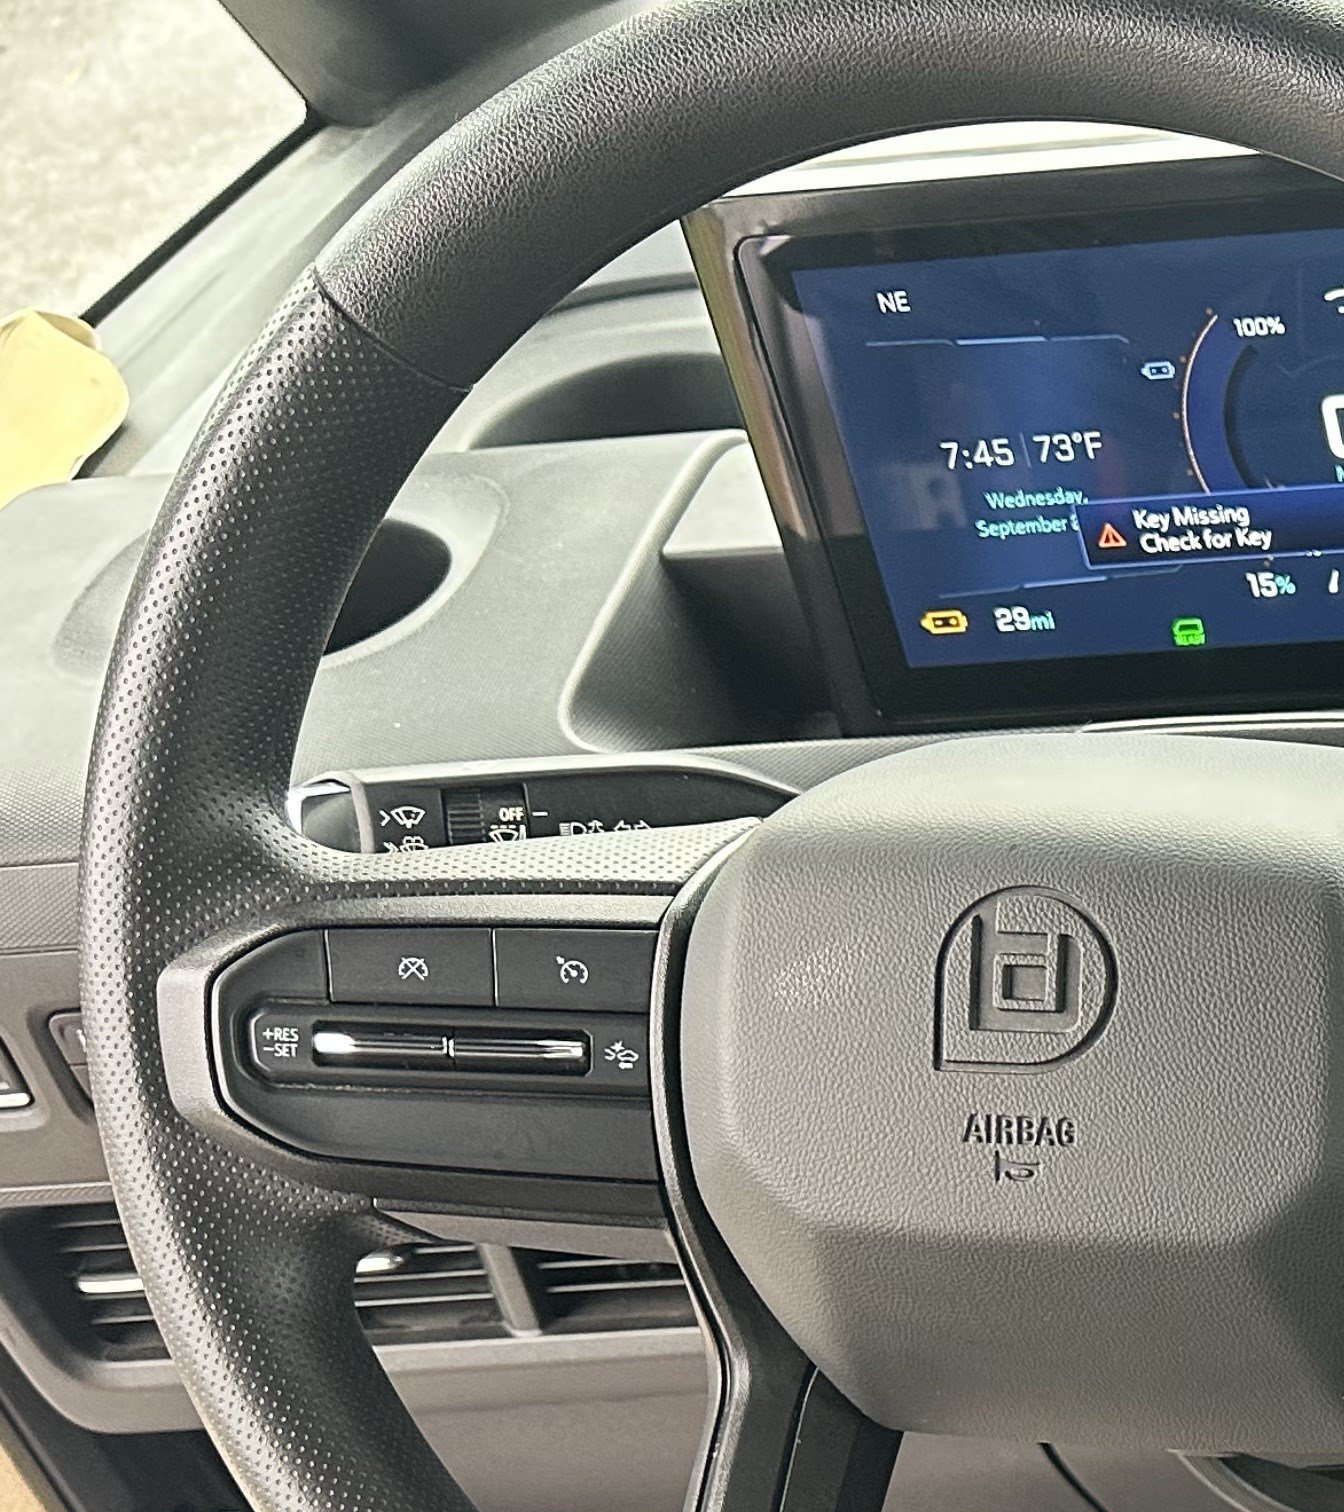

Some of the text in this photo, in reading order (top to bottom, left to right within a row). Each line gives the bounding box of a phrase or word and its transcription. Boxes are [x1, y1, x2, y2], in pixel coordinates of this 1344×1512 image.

[876, 290, 911, 313] NE
[1233, 316, 1286, 337] 100%
[941, 439, 1016, 471] 7:45
[1031, 431, 1102, 464] 73°F
[984, 487, 1089, 509] Wednesday,
[974, 515, 1068, 539] September
[1131, 503, 1250, 532] Key Missing
[1139, 526, 1272, 553] Check for Key
[1247, 573, 1297, 599] 15%
[995, 607, 1056, 633] 29mi
[499, 807, 525, 823] OFF
[262, 1026, 299, 1042] +RES
[963, 1112, 1076, 1148] AIRBAG
